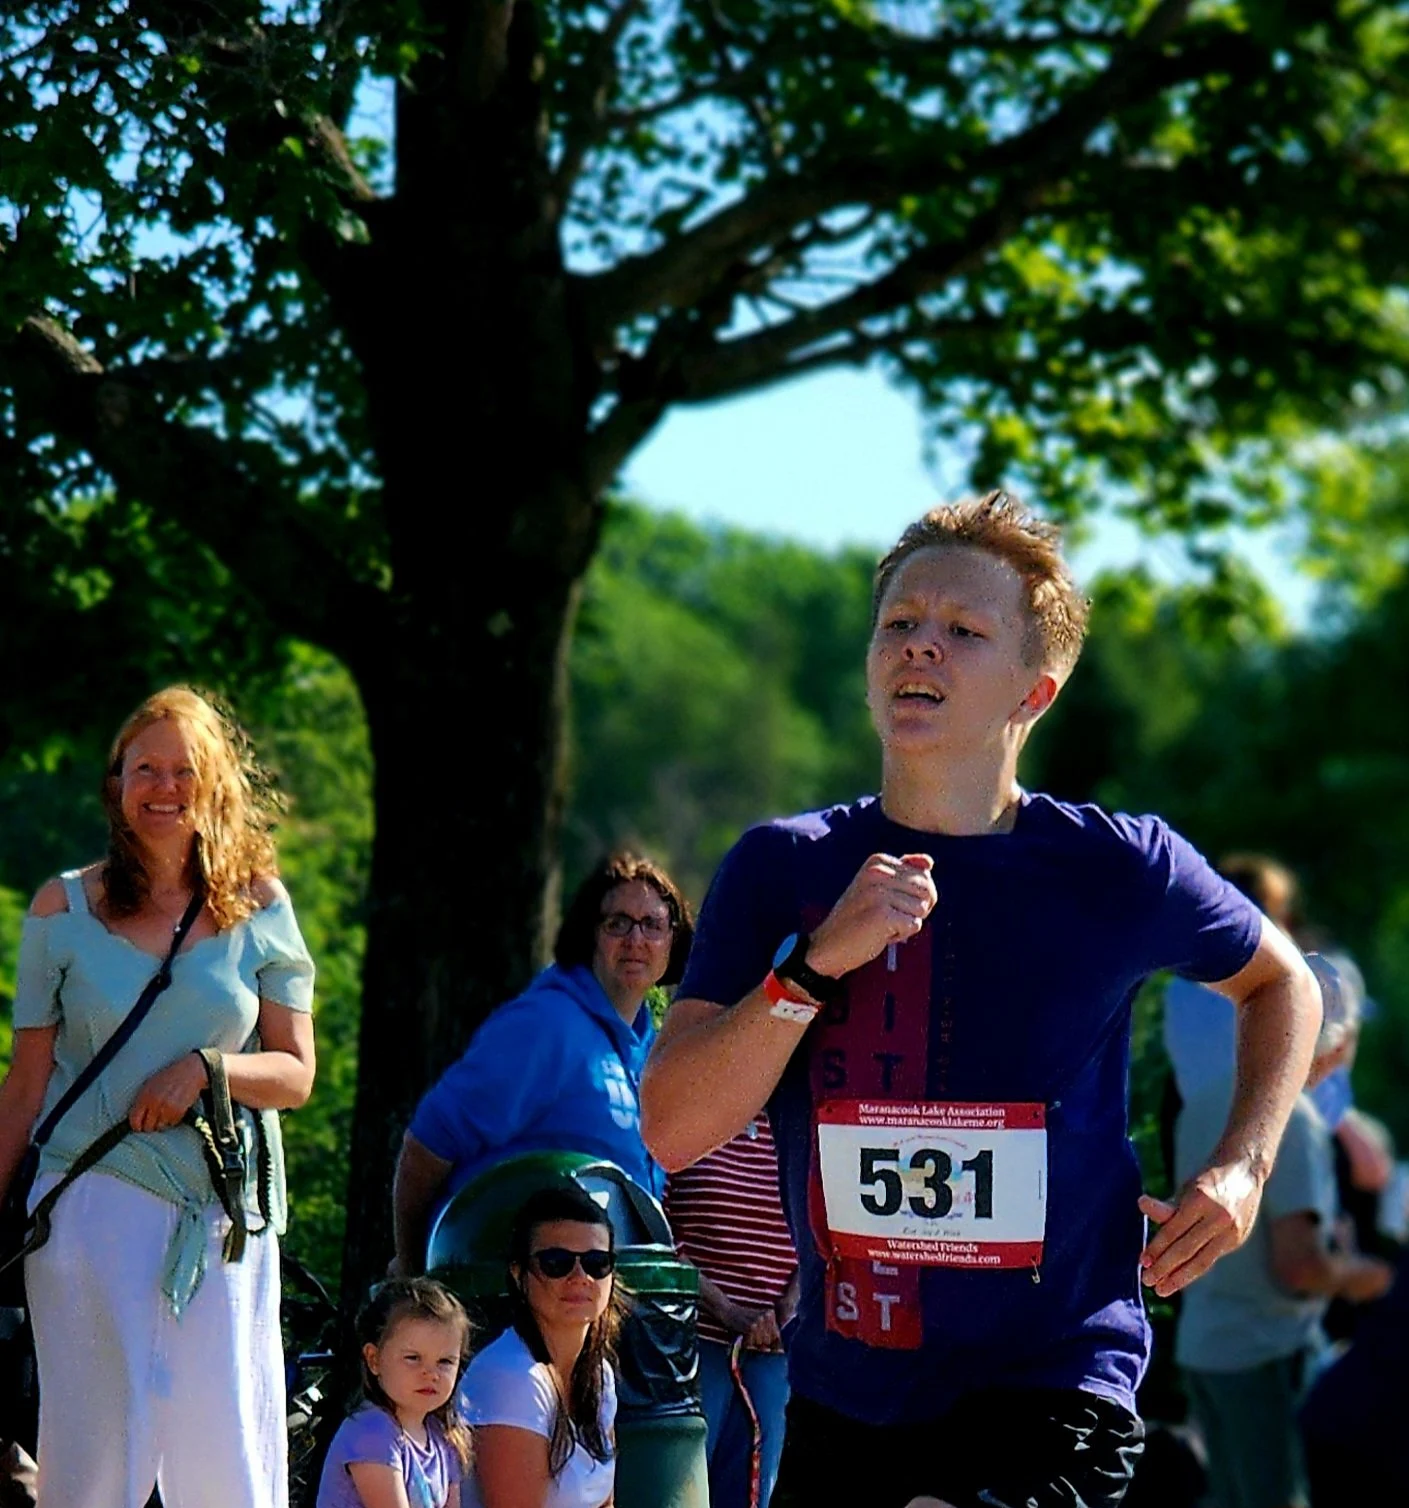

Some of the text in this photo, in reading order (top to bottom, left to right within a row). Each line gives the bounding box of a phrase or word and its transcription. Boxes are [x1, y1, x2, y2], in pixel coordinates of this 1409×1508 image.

[859, 1103, 1005, 1117] Maranacook Lake Association
[859, 1116, 1005, 1129] www.maranacooklakeme.org
[860, 1147, 993, 1220] 531
[886, 1239, 979, 1254] Watershed Friends
[867, 1249, 1001, 1264] www.watershedfriends.com
